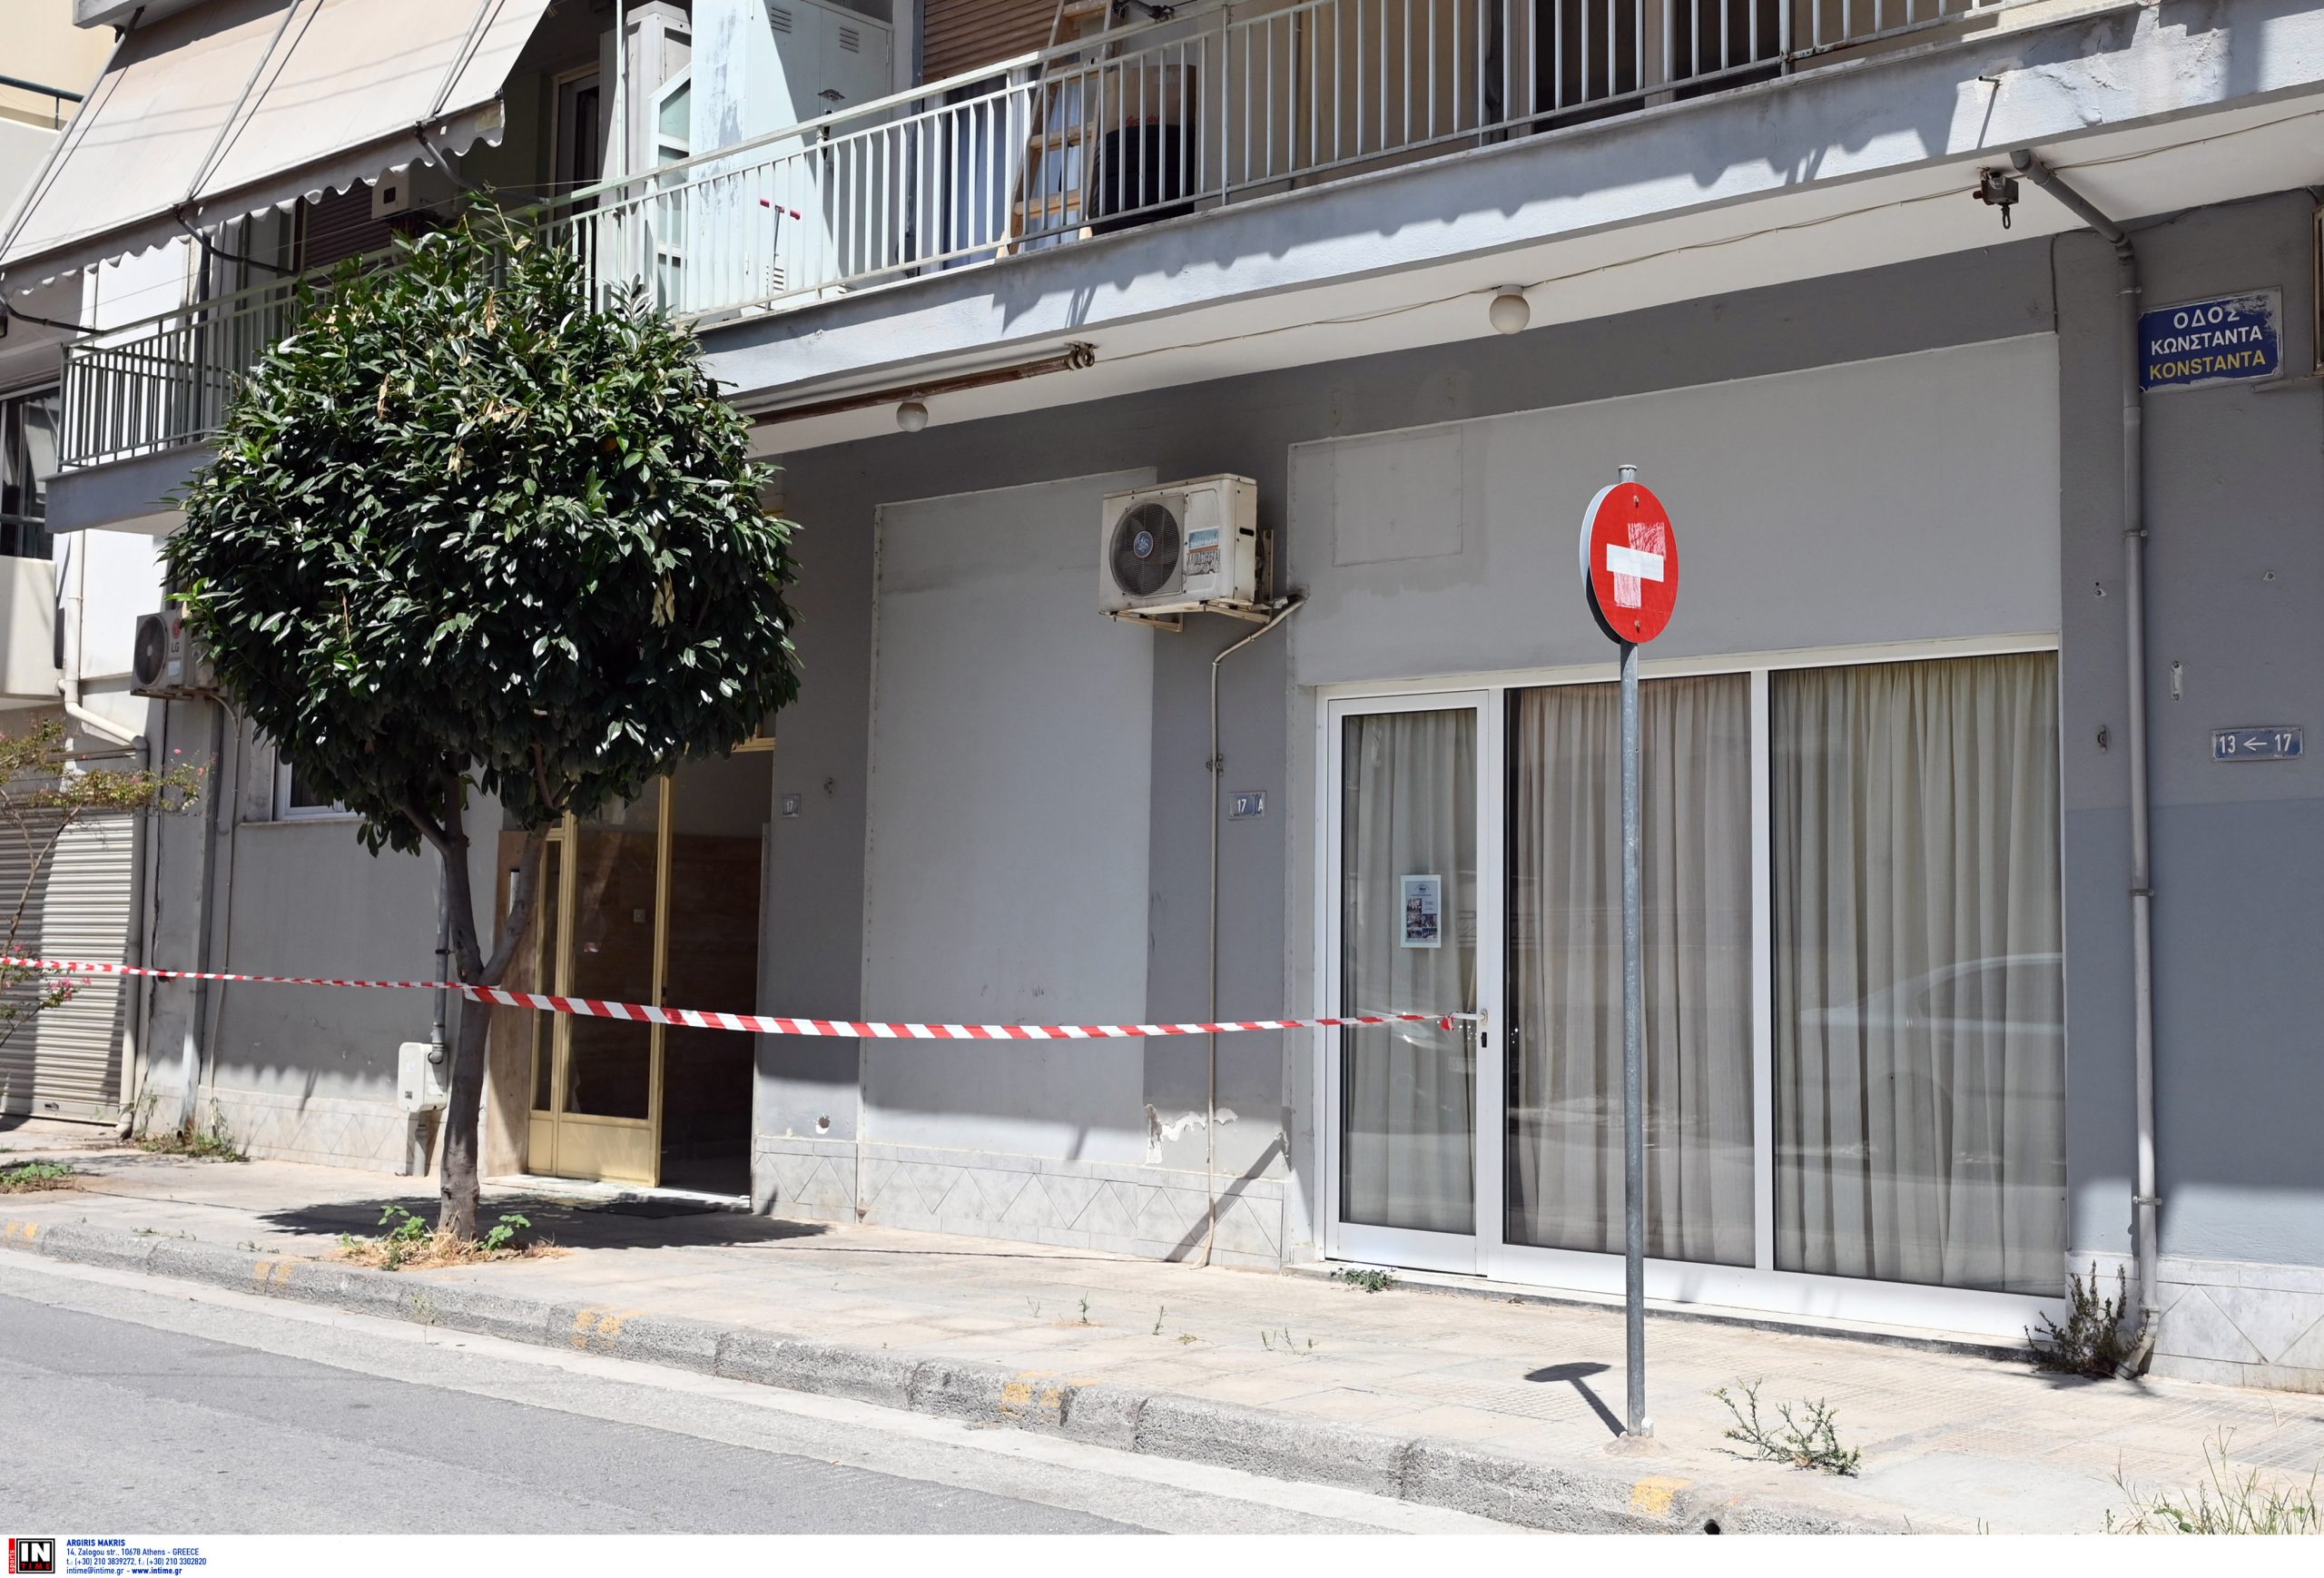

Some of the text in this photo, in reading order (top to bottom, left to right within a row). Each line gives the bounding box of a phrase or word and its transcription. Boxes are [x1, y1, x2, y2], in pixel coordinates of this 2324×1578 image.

[2173, 306, 2240, 330] ΟΔΟΣ
[2151, 325, 2263, 356] ΚΩΝΣΤΑΝΤΑ
[2149, 350, 2266, 380] KONSTANTA
[171, 641, 180, 654] LG
[2219, 733, 2292, 754] 13 17
[786, 799, 794, 814] 17
[1237, 798, 1247, 814] 17
